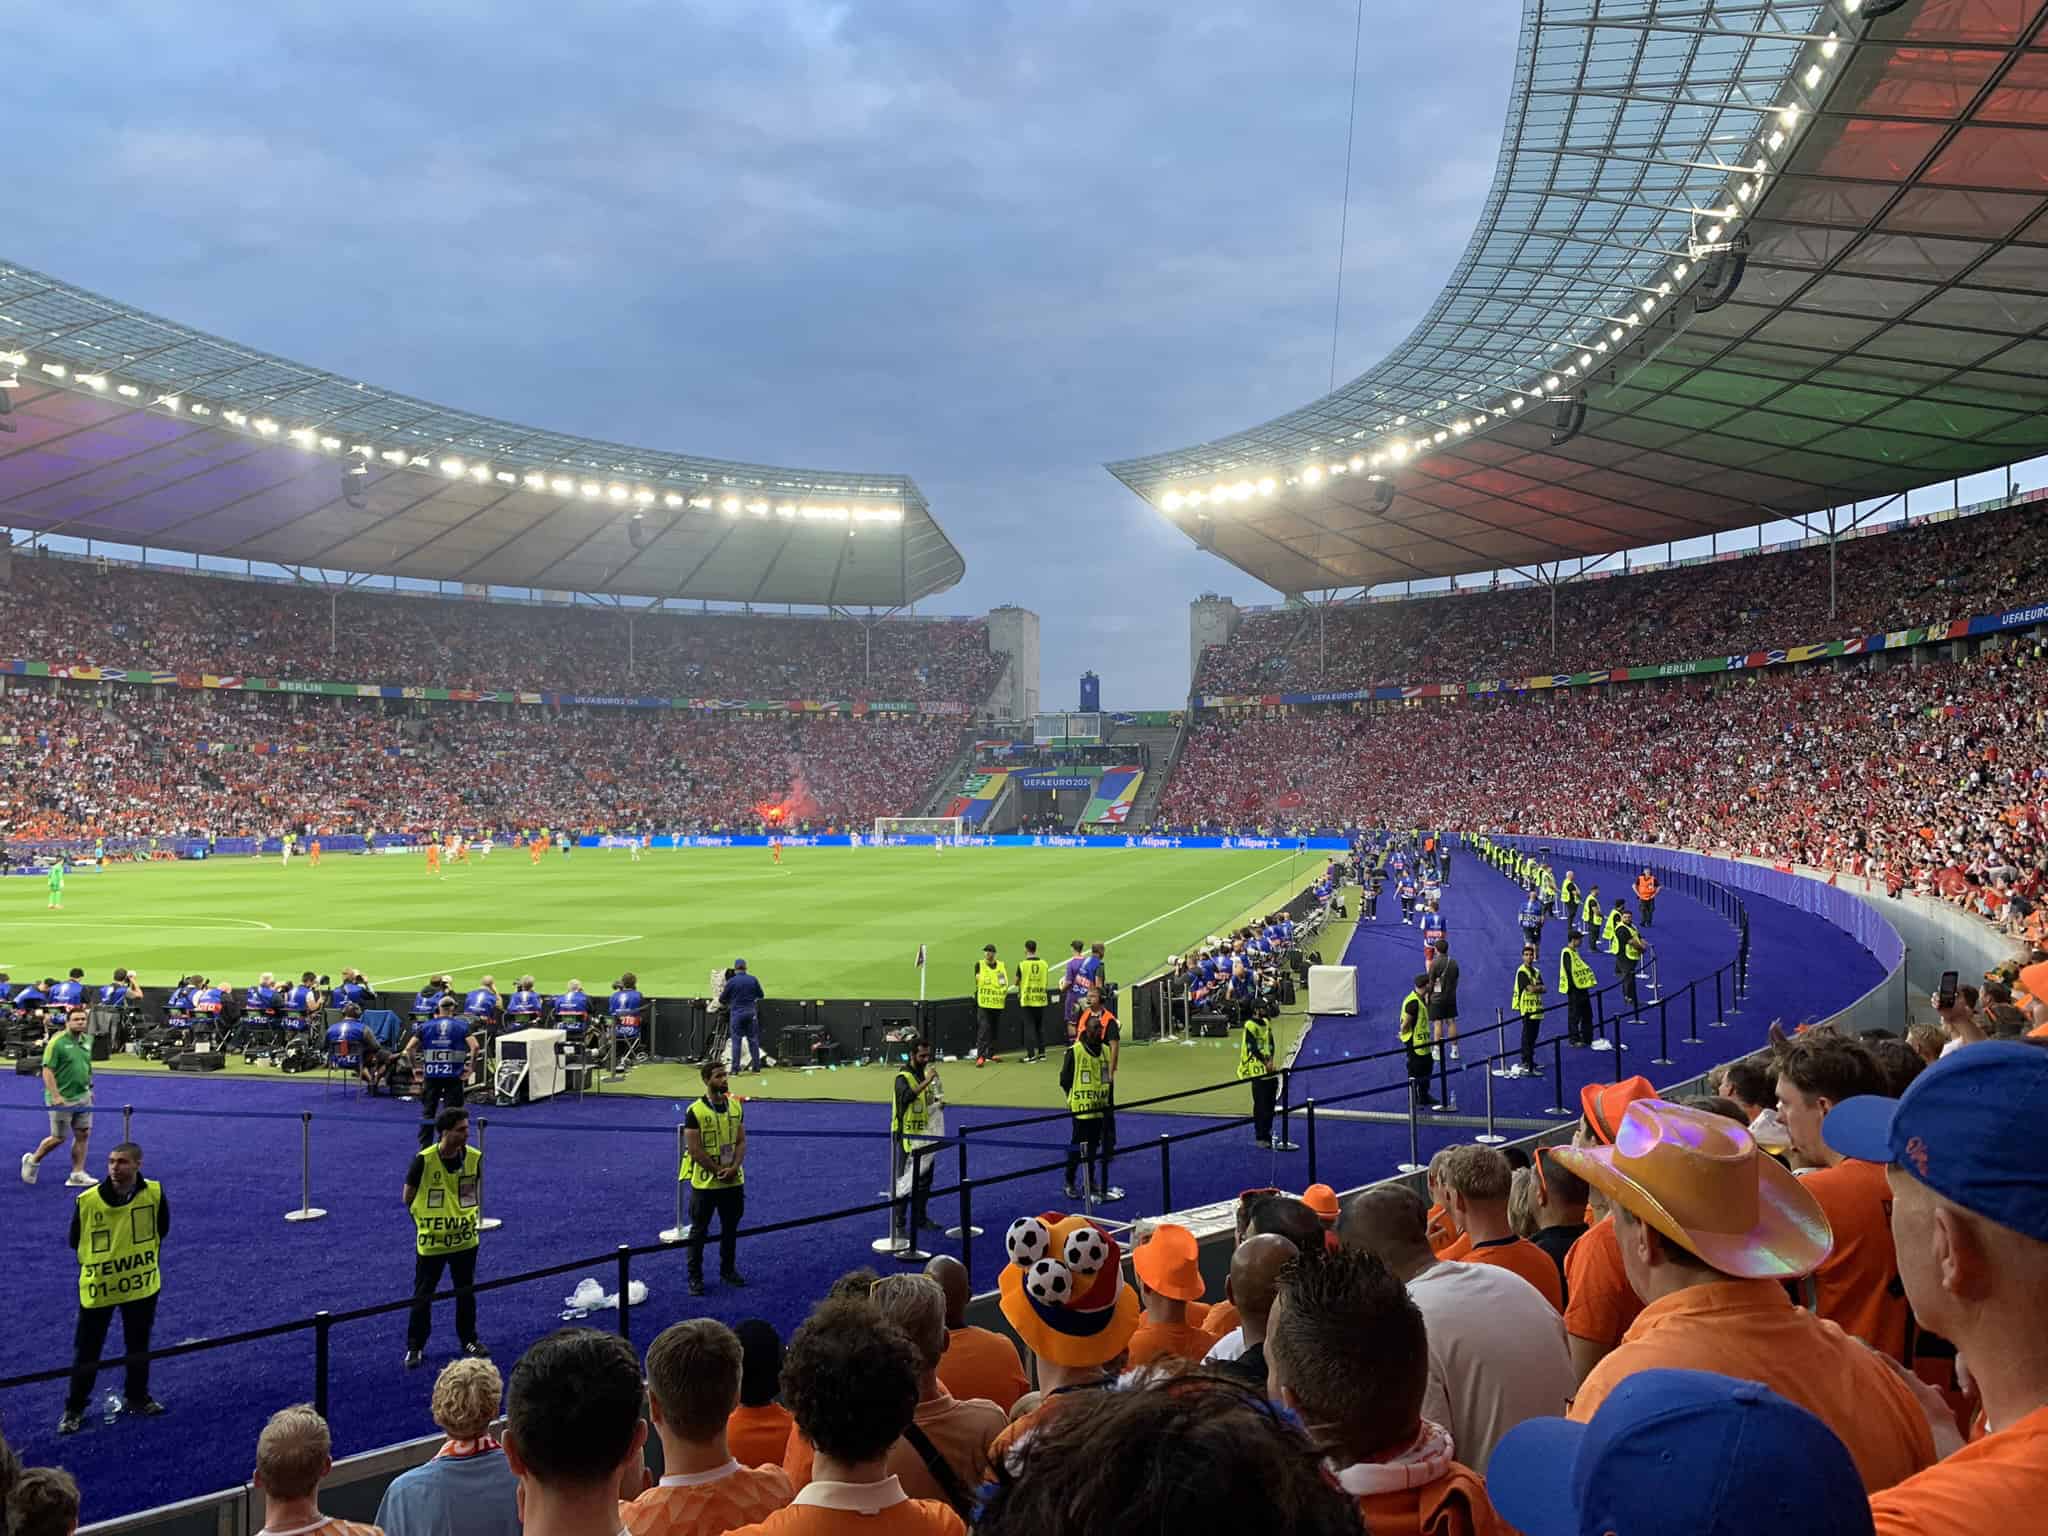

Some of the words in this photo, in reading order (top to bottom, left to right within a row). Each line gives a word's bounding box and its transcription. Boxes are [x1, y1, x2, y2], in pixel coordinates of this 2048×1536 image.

[1659, 663, 1696, 674] BERLIN
[279, 680, 323, 693] BERLIN
[432, 1051, 451, 1061] ICT
